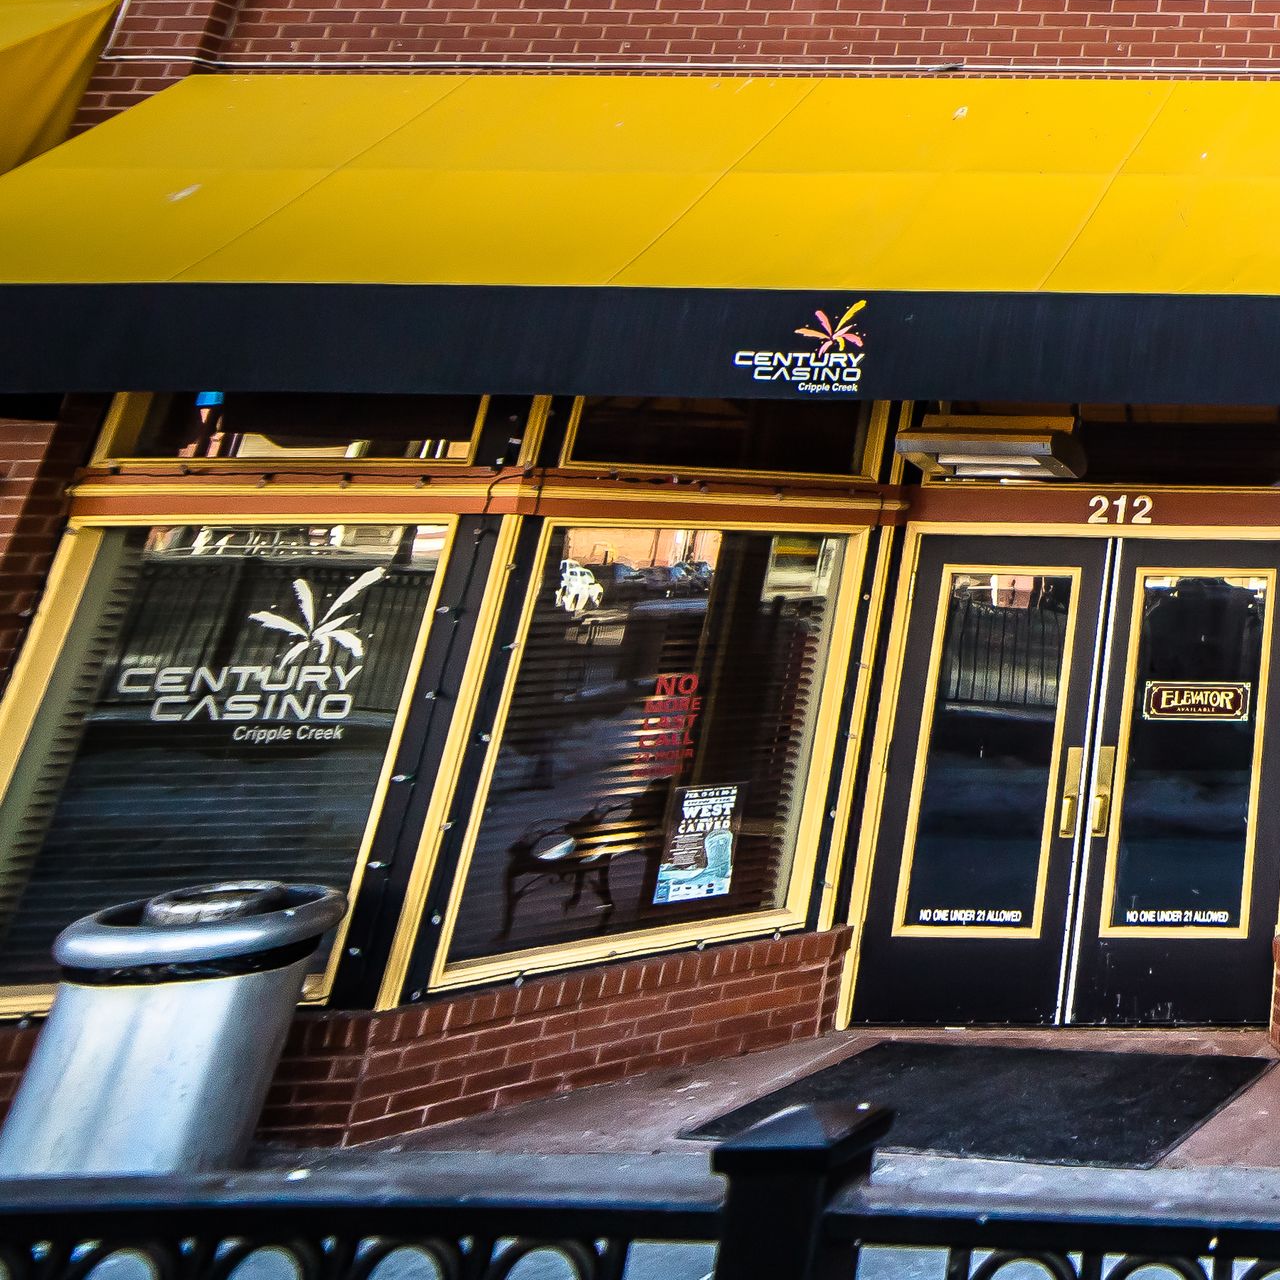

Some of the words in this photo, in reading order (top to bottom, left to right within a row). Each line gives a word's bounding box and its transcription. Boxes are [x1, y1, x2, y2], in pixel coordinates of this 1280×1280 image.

[734, 350, 866, 367] CENTURY
[753, 366, 862, 381] CASINO
[798, 382, 830, 393] Cripple
[831, 382, 858, 392] Creek
[1087, 494, 1153, 524] 212
[116, 665, 363, 694] CENTURY
[655, 673, 699, 696] NO
[150, 693, 353, 722] CASINO
[643, 696, 703, 713] MORE
[1160, 690, 1235, 710] ELEVATOR
[232, 725, 292, 744] Cripple
[296, 724, 345, 741] Creek
[682, 803, 735, 819] WEST
[919, 909, 932, 921] NO
[933, 909, 949, 921] ONE
[950, 909, 976, 921] UNDER
[976, 909, 986, 921] 21
[986, 910, 1022, 922] ALLOWED
[1126, 910, 1138, 923] NO
[1140, 910, 1156, 922] ONE
[1157, 910, 1182, 922] UNDER
[1183, 910, 1193, 922] 21
[1193, 910, 1229, 923] ALLOWED
